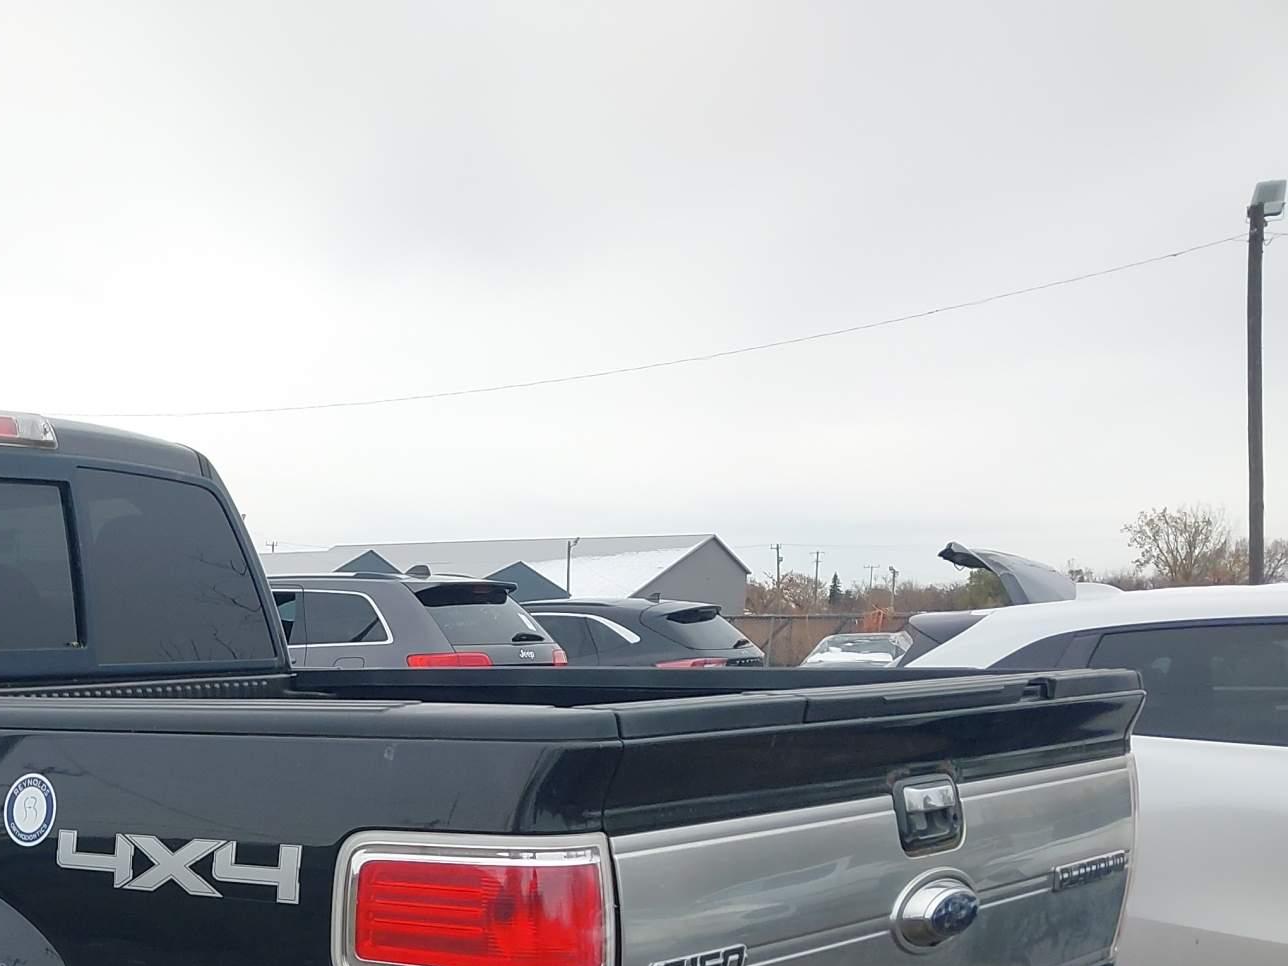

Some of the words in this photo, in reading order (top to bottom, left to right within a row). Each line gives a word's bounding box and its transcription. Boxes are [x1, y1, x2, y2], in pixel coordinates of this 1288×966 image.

[519, 648, 535, 660] Jeep
[13, 778, 51, 797] REYNOLDS
[10, 821, 49, 841] ORTHODONTICS
